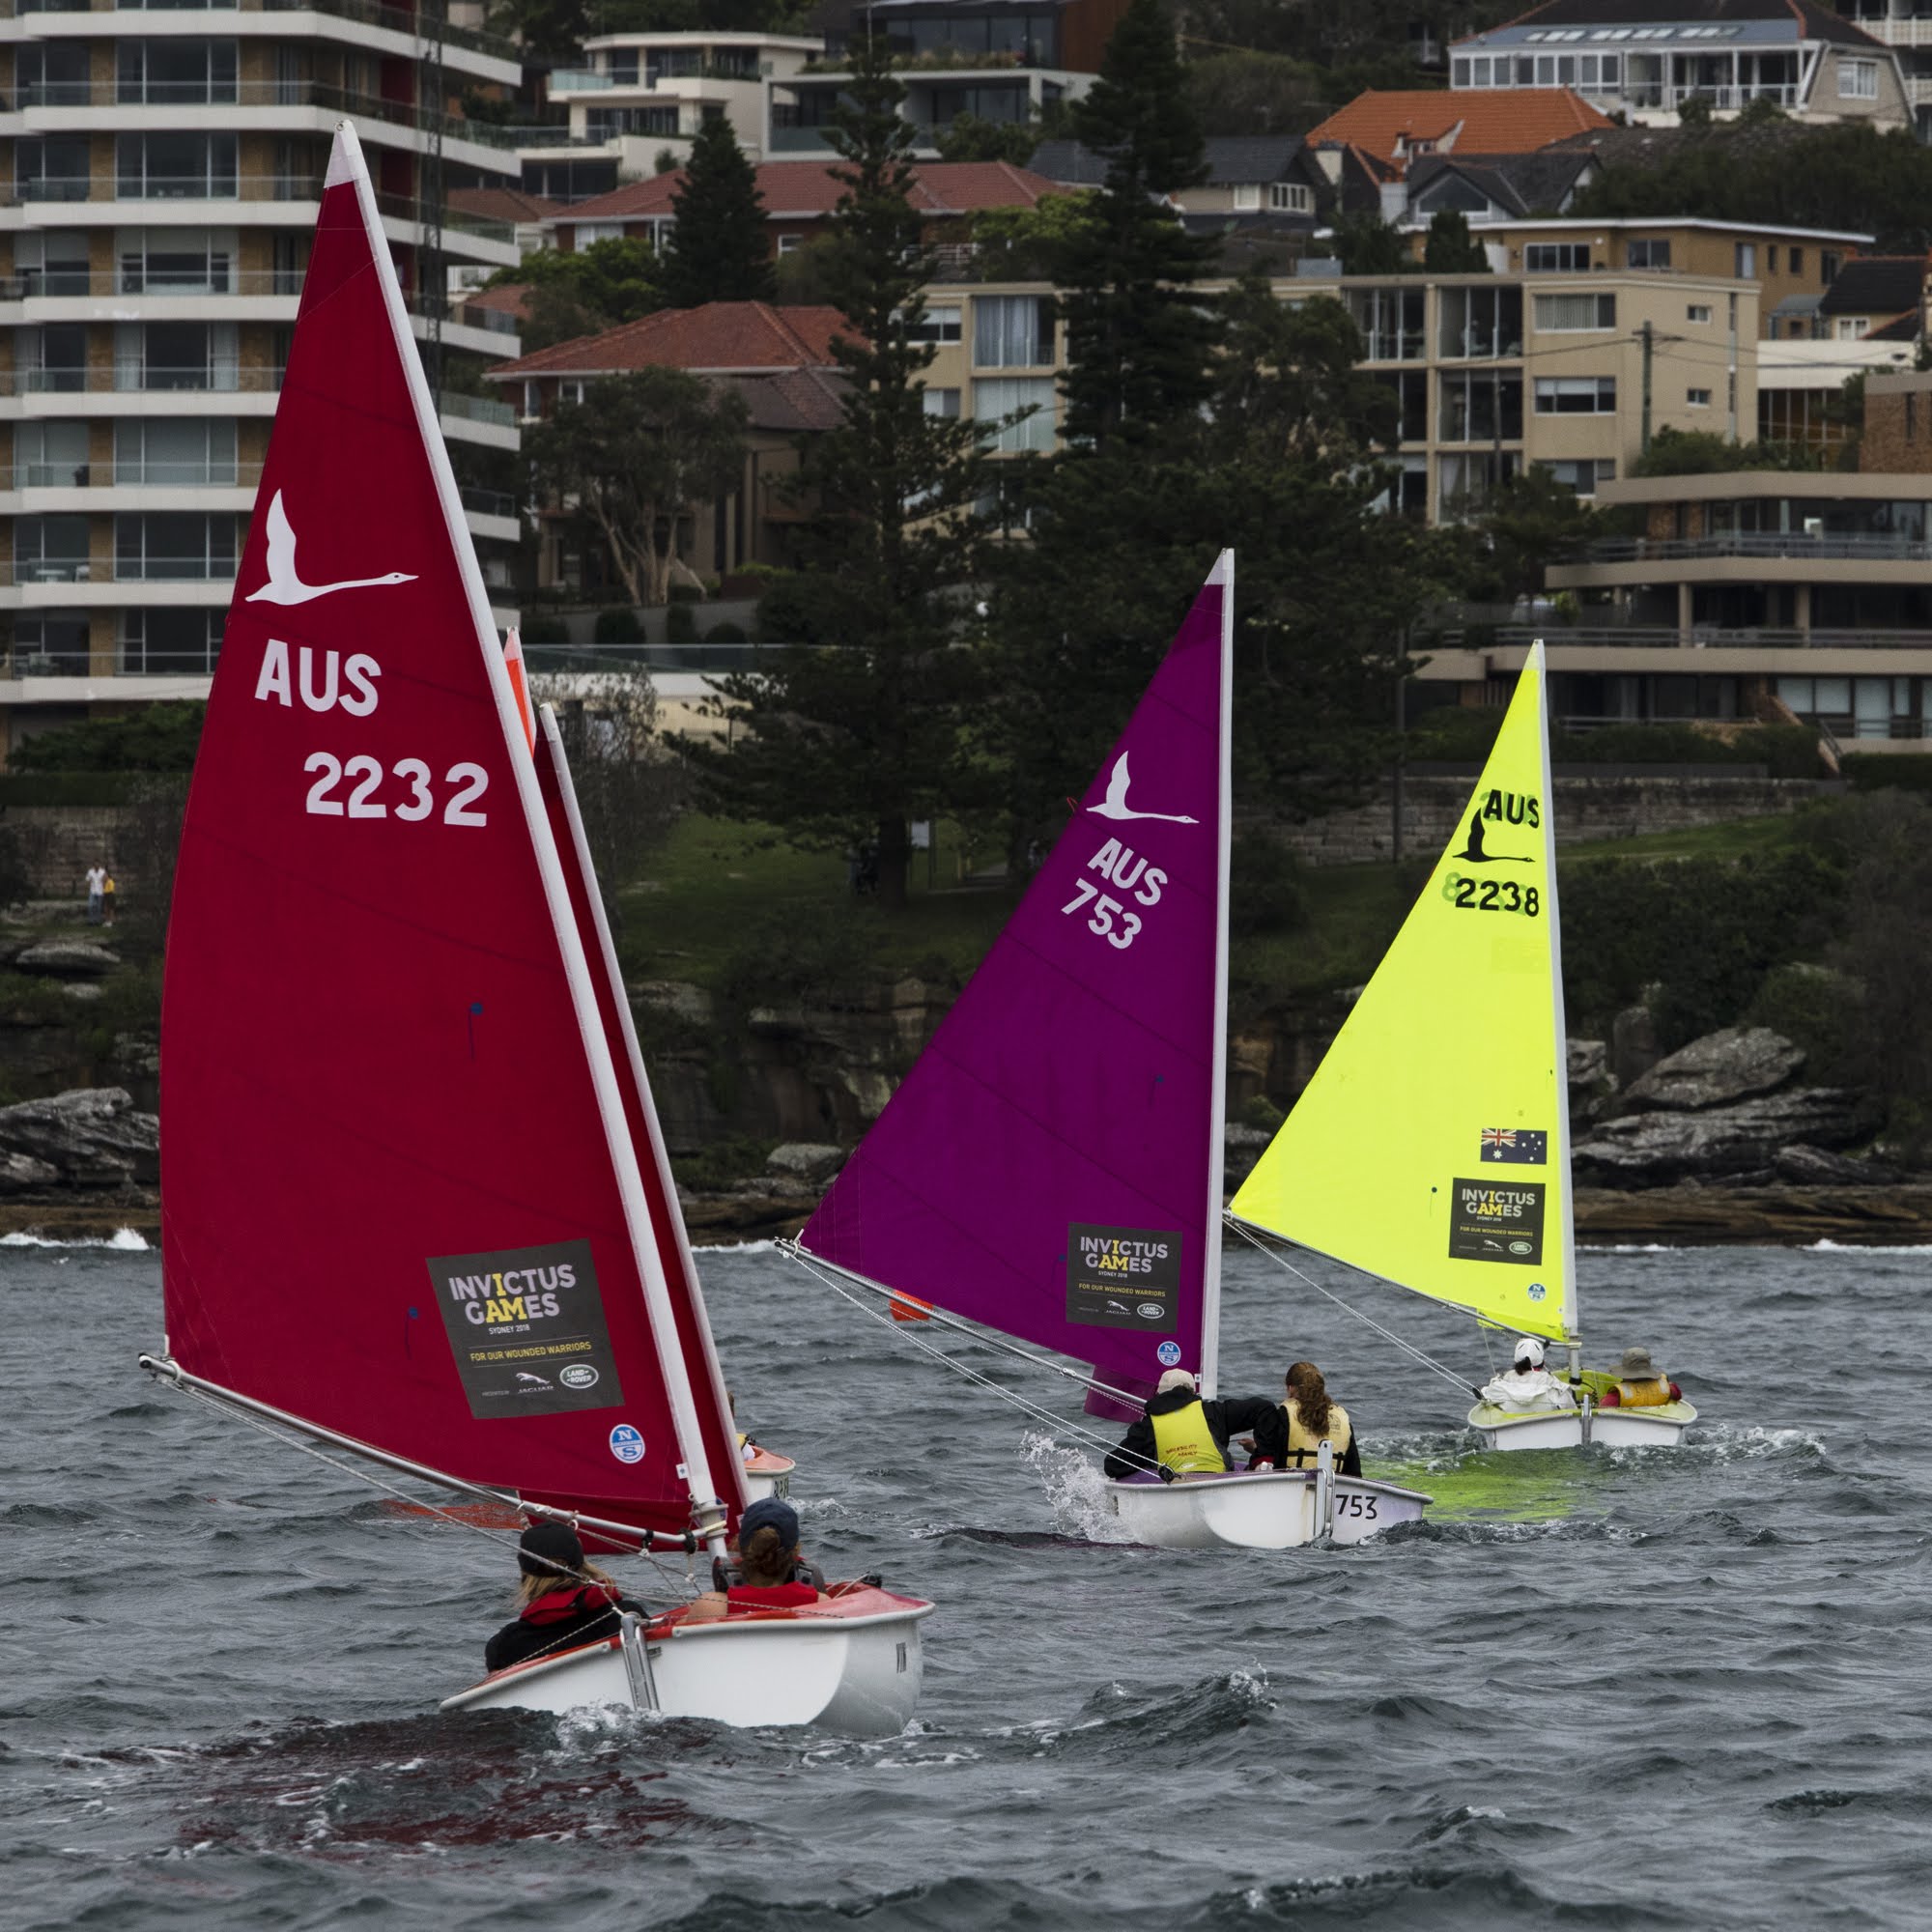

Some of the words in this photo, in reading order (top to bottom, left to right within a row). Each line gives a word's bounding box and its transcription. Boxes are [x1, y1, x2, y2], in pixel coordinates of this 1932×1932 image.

[254, 638, 382, 717] AUS
[303, 752, 489, 827] 2232
[1483, 789, 1540, 829] AUS
[1087, 837, 1168, 906] AUS
[1455, 878, 1540, 917] 2238
[1061, 877, 1142, 950] 753
[1462, 1188, 1535, 1206] INVICTUS
[1465, 1203, 1522, 1217] GAMES
[1080, 1236, 1168, 1259] INVICTUS
[1085, 1253, 1152, 1273] GAMES
[447, 1264, 577, 1300] INVICTUS
[1104, 1286, 1134, 1294] WOUNDED
[1135, 1289, 1166, 1297] WARRIORS
[465, 1293, 560, 1325] GAMES
[489, 1325, 514, 1335] SYDNEY
[516, 1323, 530, 1333] 2018
[469, 1352, 487, 1362] FOR
[488, 1351, 504, 1360] OUR
[504, 1348, 547, 1358] WOUNDED
[547, 1341, 592, 1353] WARRIORS
[616, 1430, 633, 1441] N
[622, 1446, 638, 1457] S
[1335, 1493, 1378, 1520] 753
